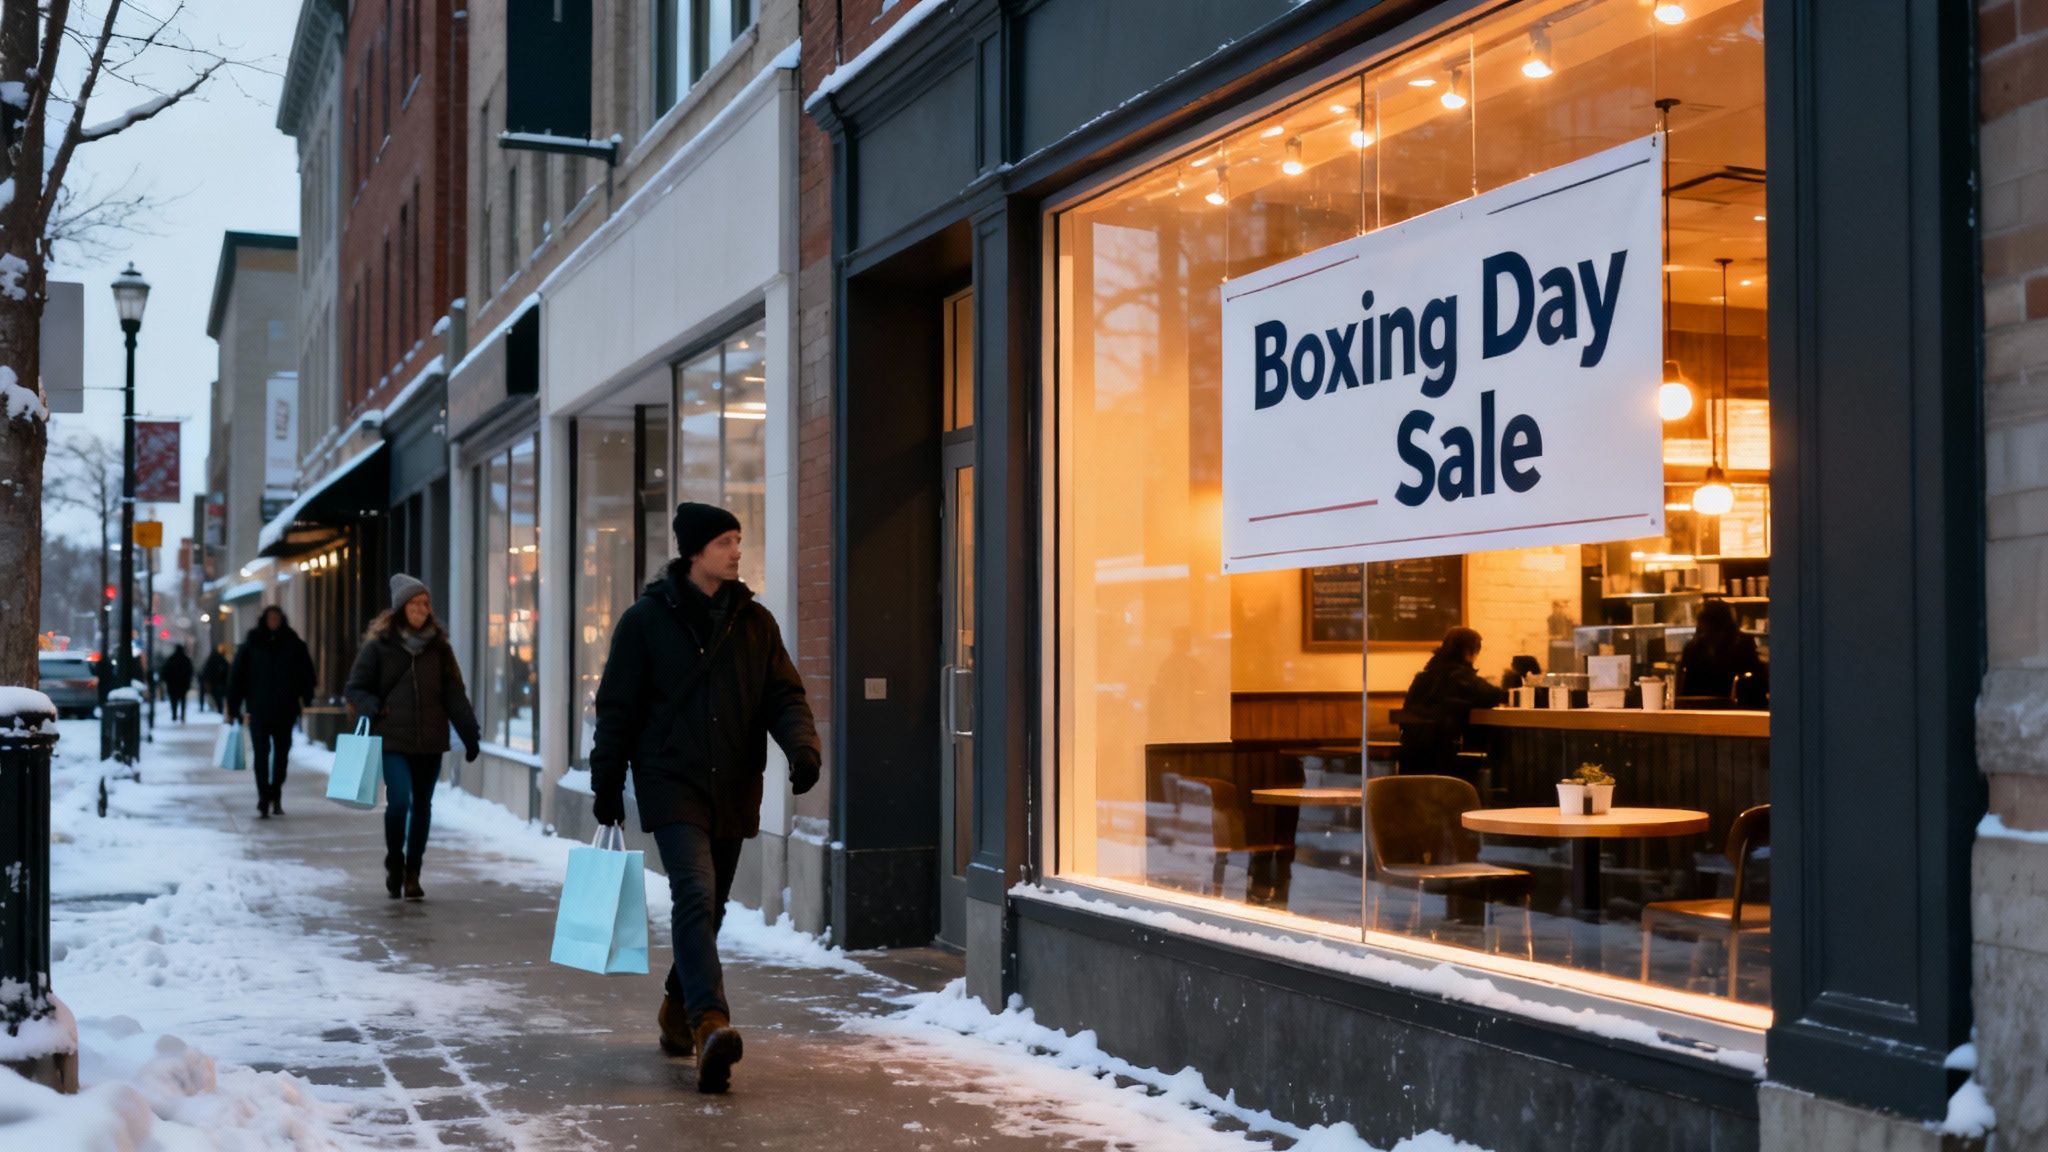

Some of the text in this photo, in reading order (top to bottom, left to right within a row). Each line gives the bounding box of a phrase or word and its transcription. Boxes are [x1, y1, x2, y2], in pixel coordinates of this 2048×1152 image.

[1254, 249, 1628, 411] Boxing Day
[1394, 389, 1543, 507] Sale
